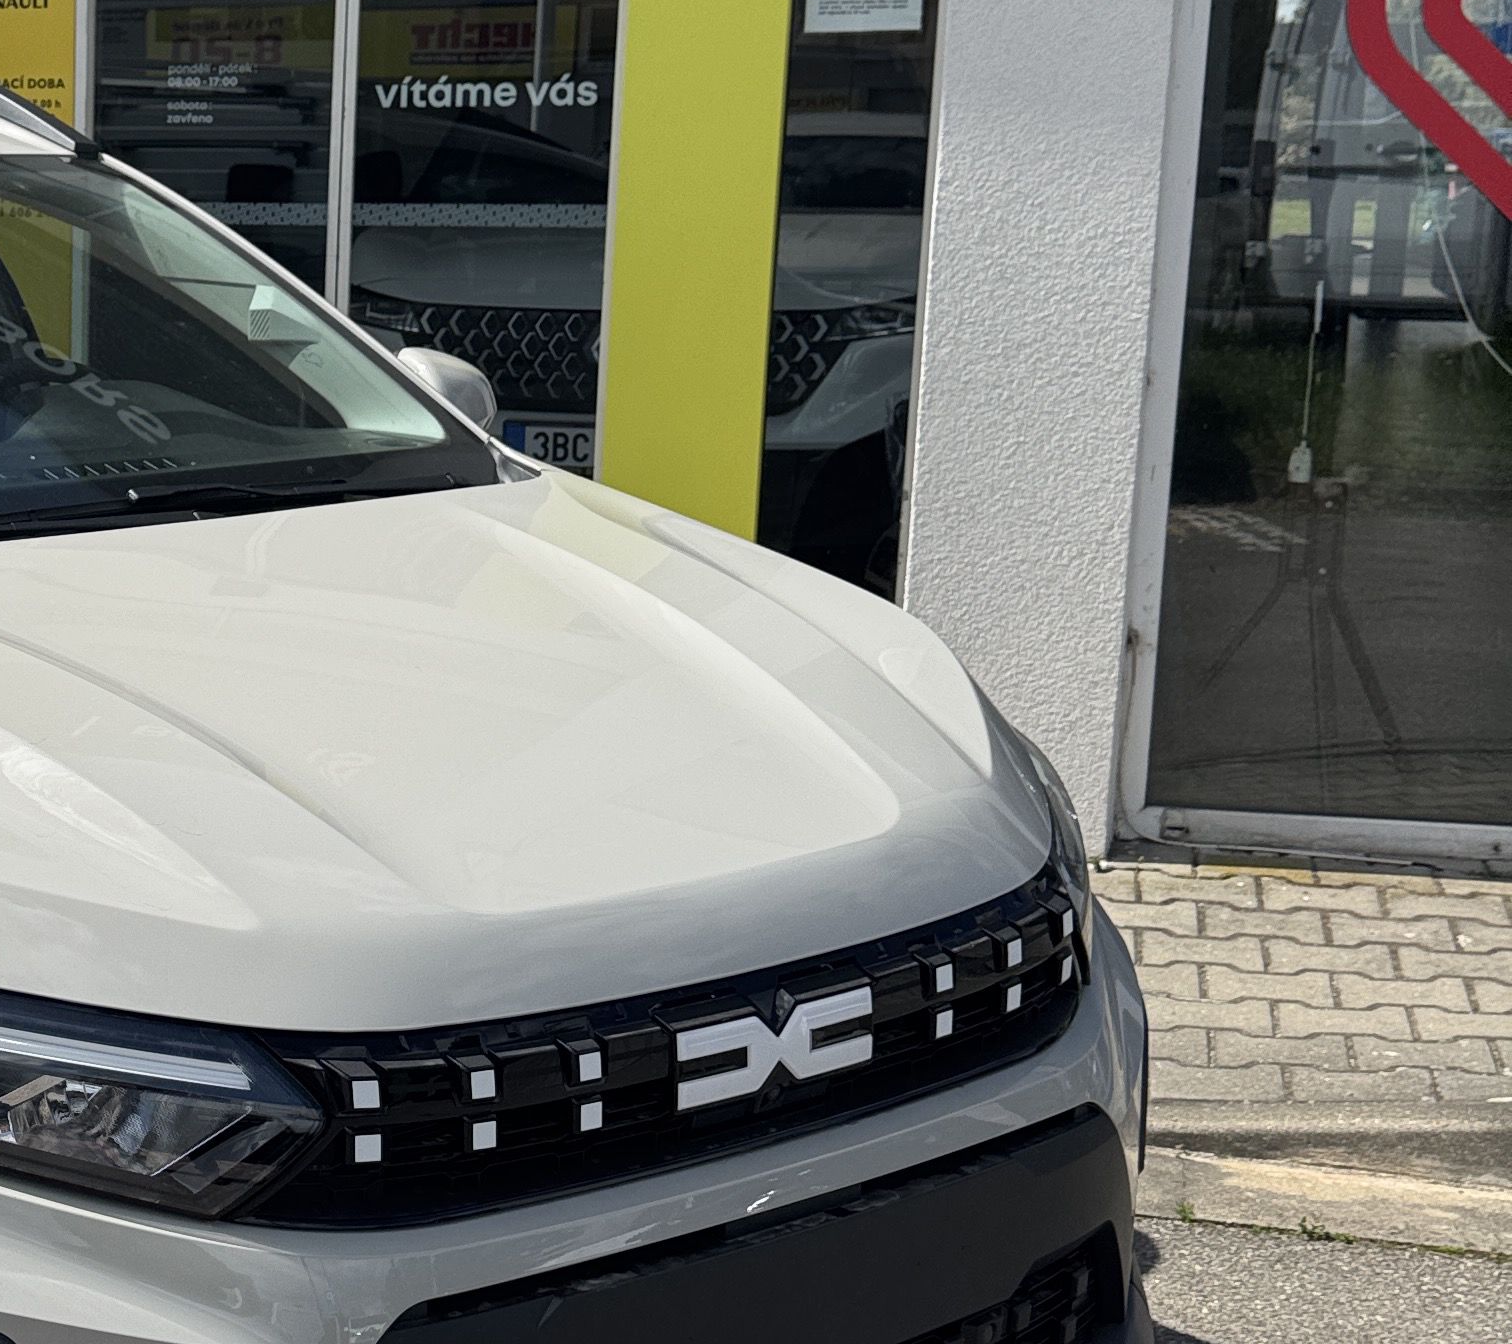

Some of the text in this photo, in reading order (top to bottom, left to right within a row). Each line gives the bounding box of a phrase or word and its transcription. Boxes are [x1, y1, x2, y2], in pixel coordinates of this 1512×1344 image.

[28, 77, 65, 89] DOBA
[375, 73, 599, 109] vítáme vás
[532, 431, 590, 463] 3BC
